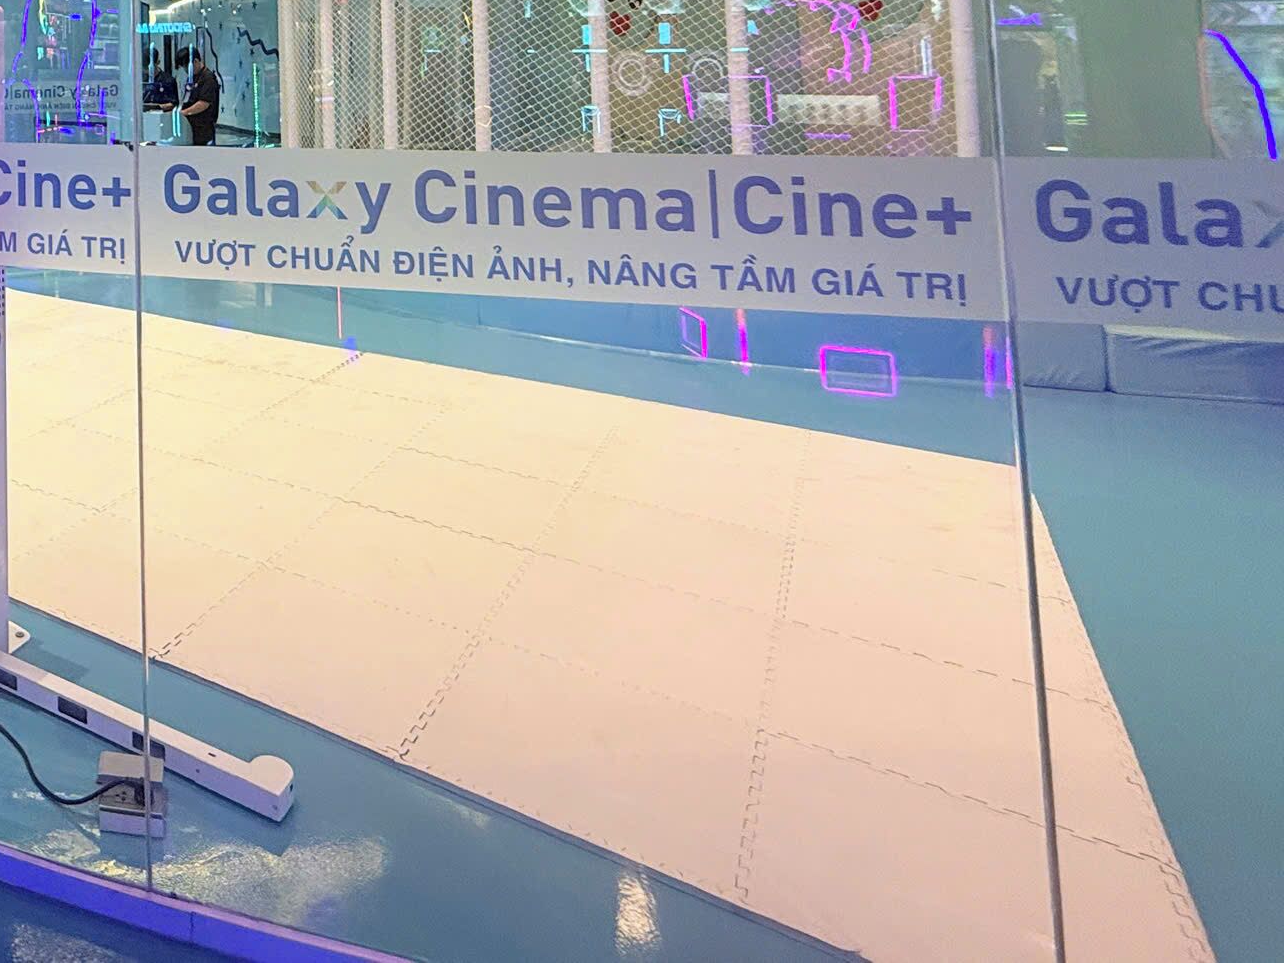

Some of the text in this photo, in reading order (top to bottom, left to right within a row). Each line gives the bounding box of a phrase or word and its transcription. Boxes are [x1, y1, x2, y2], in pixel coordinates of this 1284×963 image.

[163, 163, 392, 234] Galaxy
[26, 229, 71, 257] GIÁ
[80, 236, 126, 265] TRỊ
[174, 235, 967, 308] VƯỢT CHUẨN ĐIỆN ẢNH, NÂNG TẦM GIÁ TRỊ
[1056, 273, 1180, 314] VƯỢT
